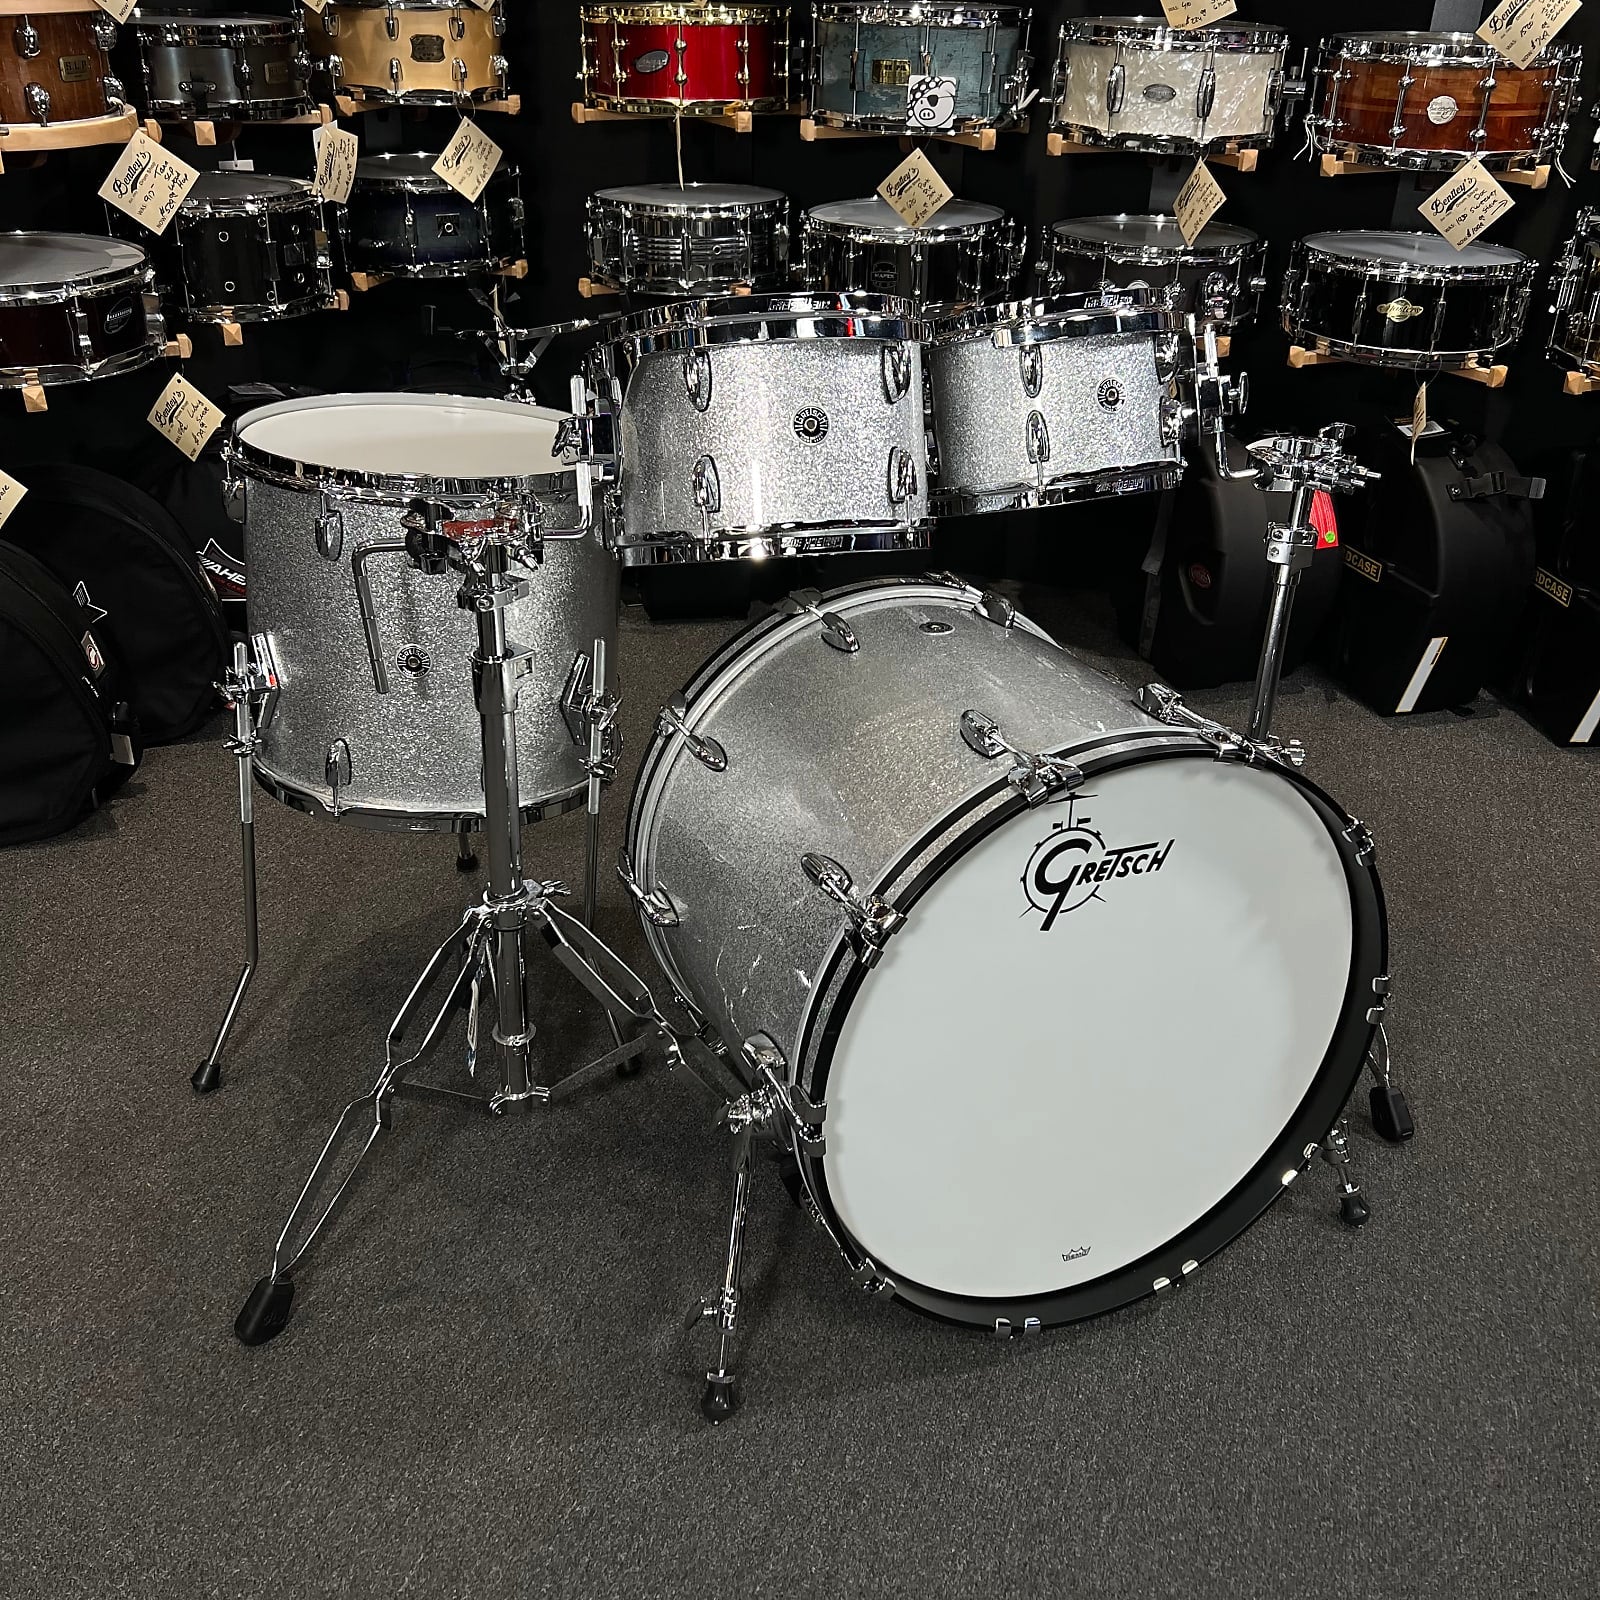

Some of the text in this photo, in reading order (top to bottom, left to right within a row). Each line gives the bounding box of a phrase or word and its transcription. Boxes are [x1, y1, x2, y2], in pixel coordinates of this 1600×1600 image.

[113, 151, 151, 199] Bentley's
[1431, 177, 1477, 217] Bentley's
[155, 391, 185, 428] Bentley's
[795, 408, 828, 424] GRETSCH
[205, 563, 247, 586] AHE
